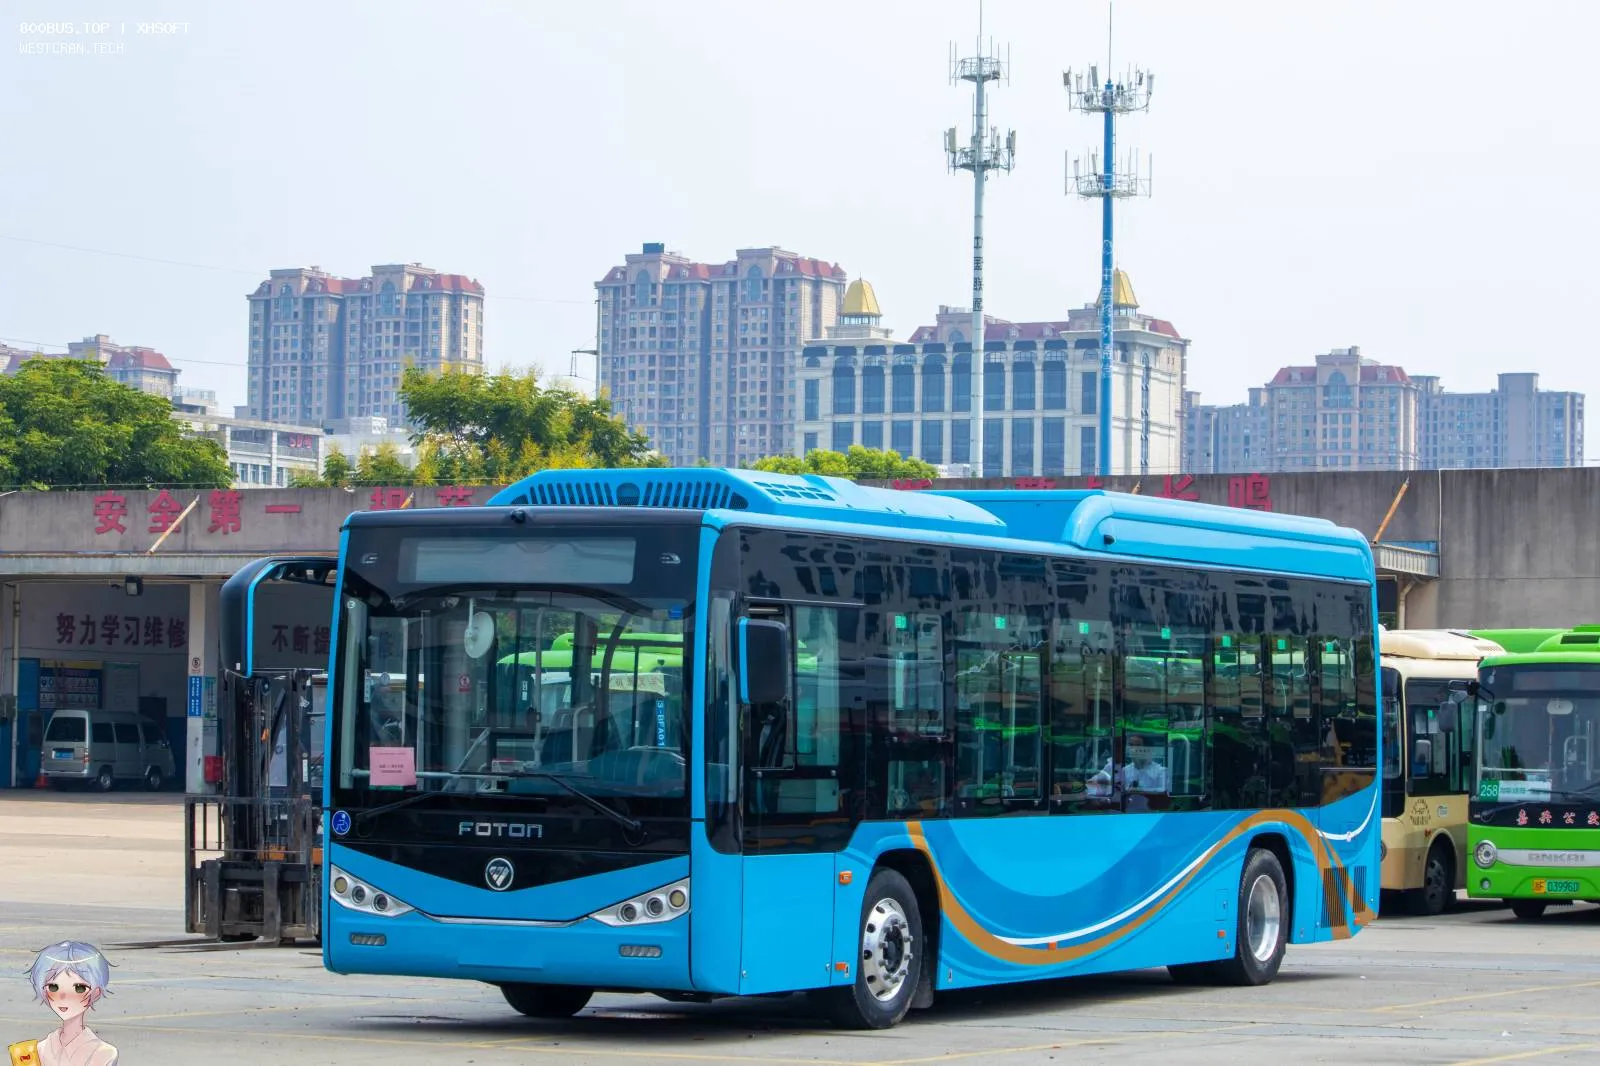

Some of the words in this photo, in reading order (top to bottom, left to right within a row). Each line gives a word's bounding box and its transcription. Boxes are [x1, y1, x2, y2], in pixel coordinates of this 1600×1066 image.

[94, 488, 301, 534] 安全第一
[57, 612, 187, 648] 努力学习维修
[1480, 784, 1498, 797] 258
[458, 821, 543, 838] FOTON
